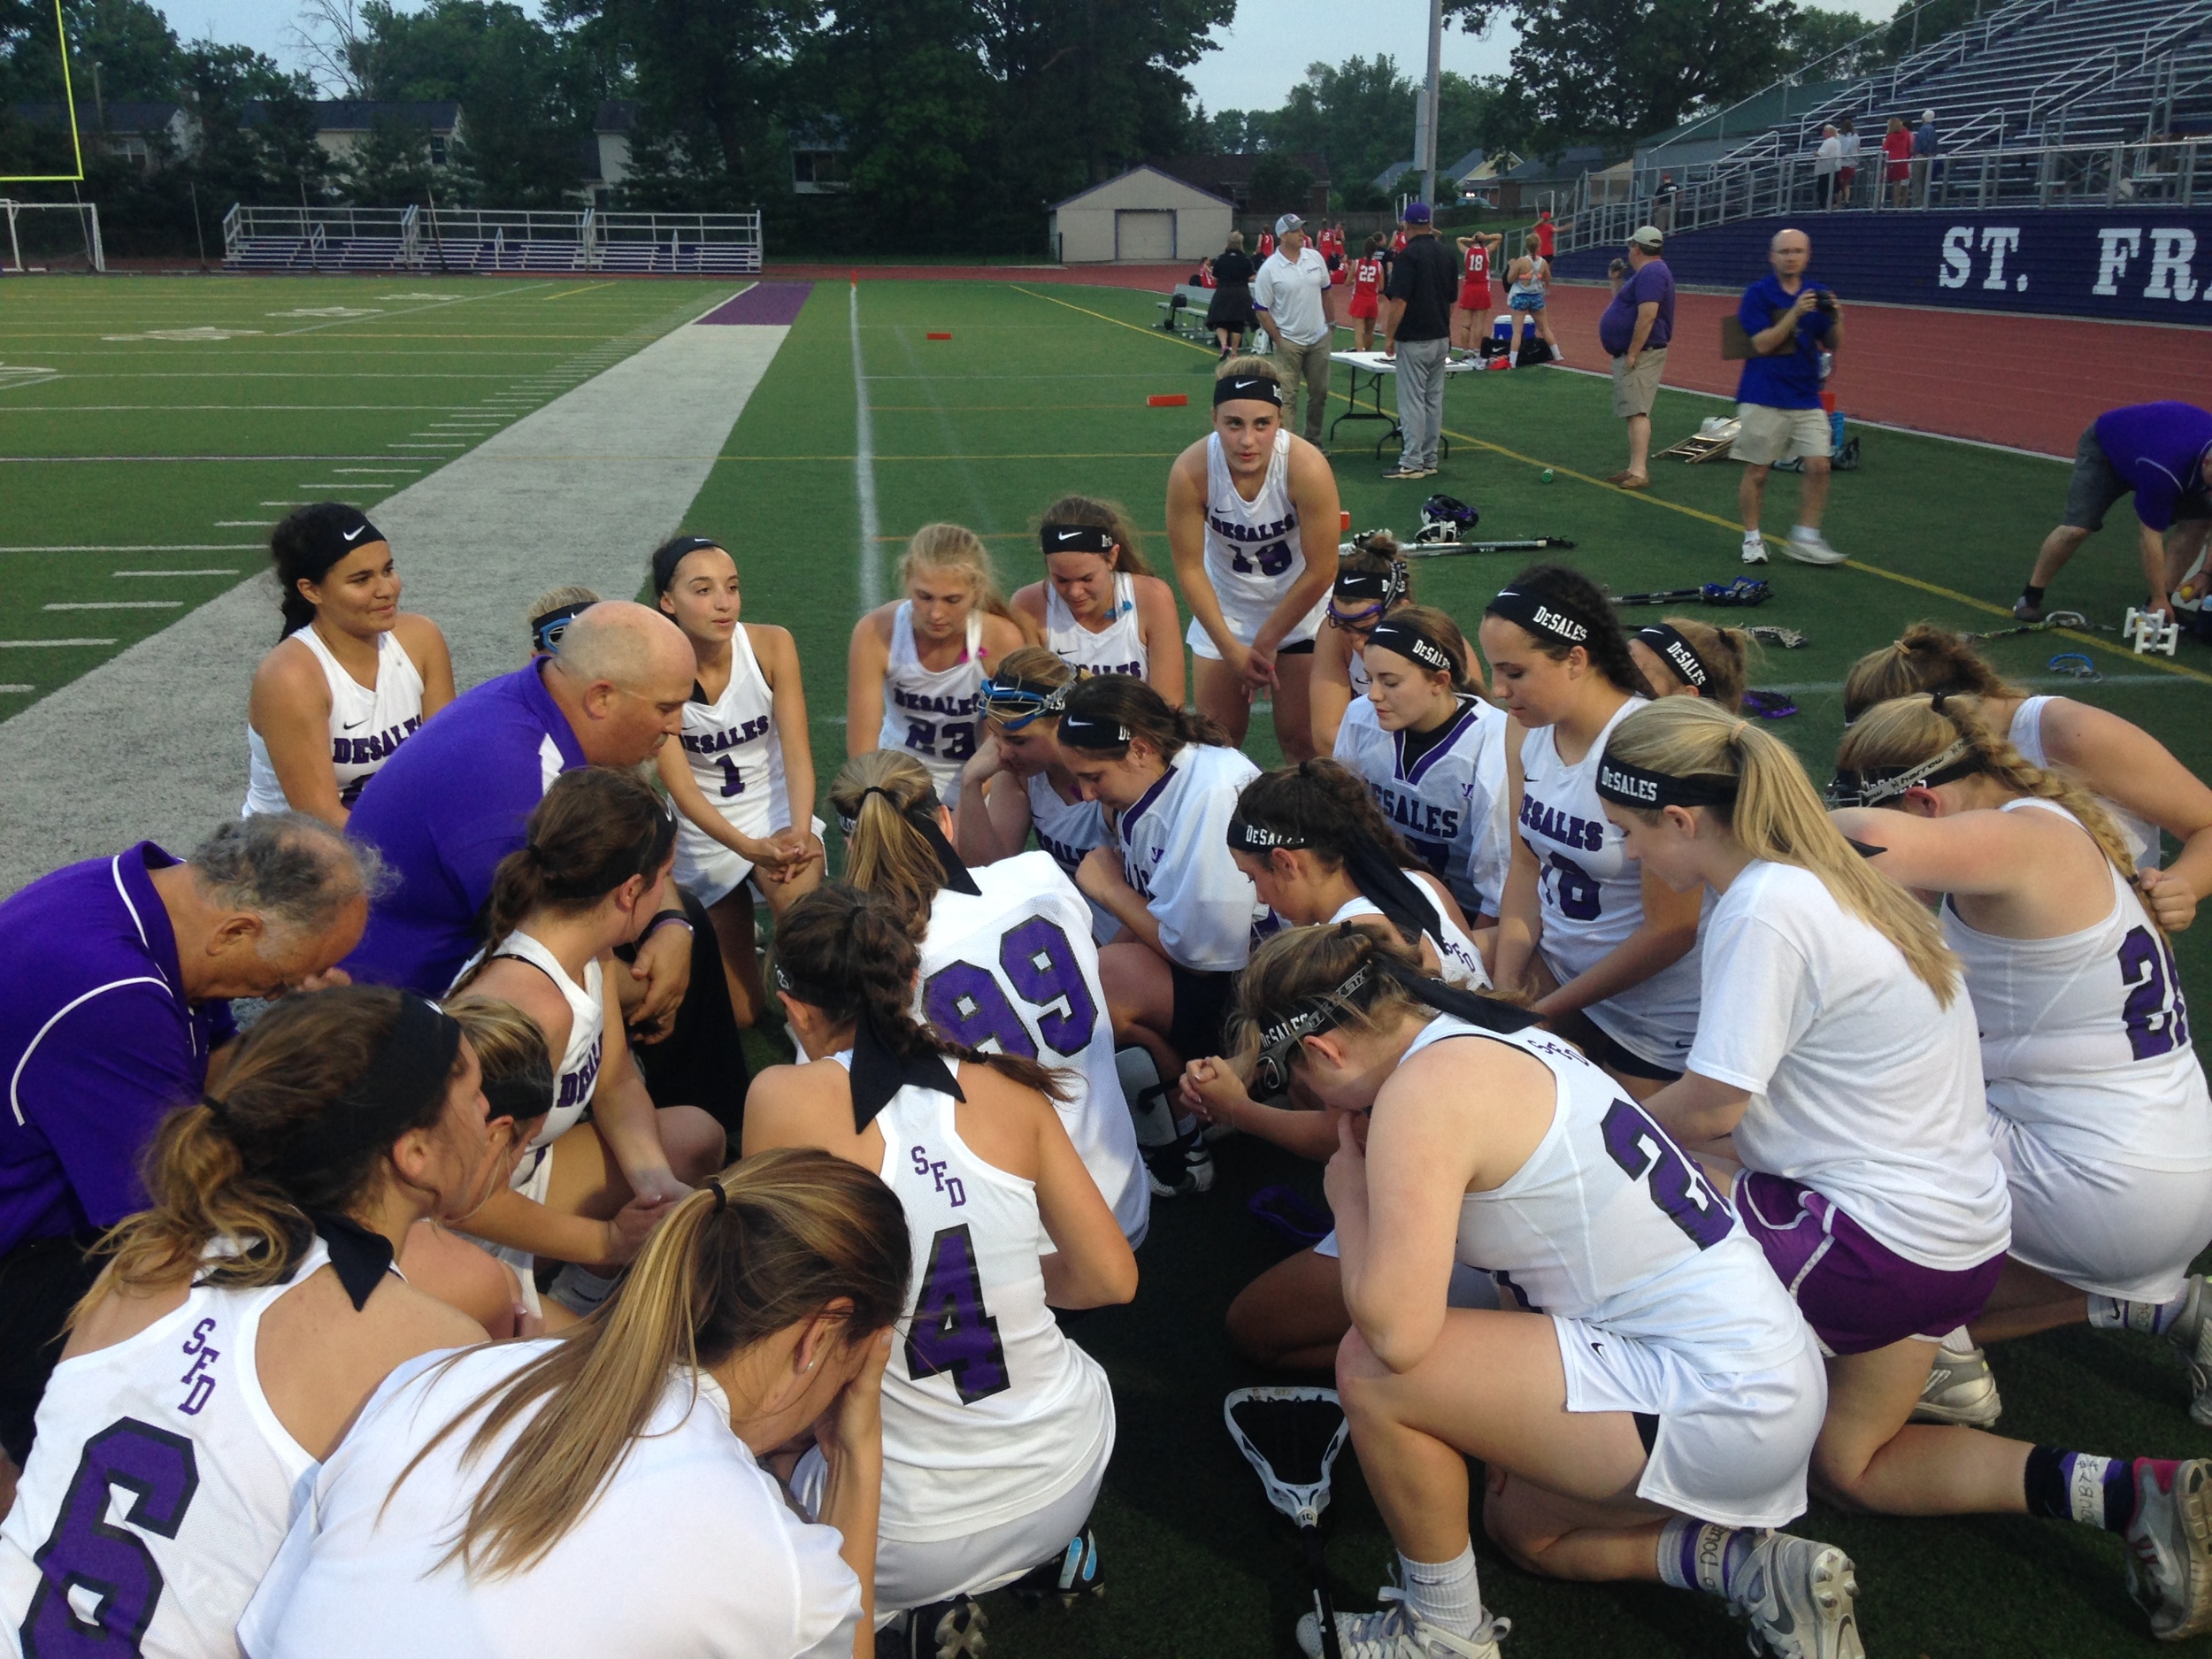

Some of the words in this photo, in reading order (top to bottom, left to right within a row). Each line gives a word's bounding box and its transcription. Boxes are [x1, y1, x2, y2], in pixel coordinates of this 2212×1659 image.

[1358, 265, 1377, 283] 22
[1469, 254, 1484, 272] 18
[1939, 227, 2028, 292] ST.
[2092, 227, 2212, 302] FR
[1210, 513, 1295, 542] DESALES
[679, 715, 769, 754] ESALES
[904, 715, 977, 761] 23
[714, 753, 745, 798] 1
[1520, 793, 1604, 852] ESALES
[921, 914, 1098, 1060] 99
[1527, 1040, 1589, 1067] SFD
[910, 1145, 967, 1207] SFD
[1600, 1097, 1733, 1250] 2
[904, 1223, 1011, 1406] 4
[178, 1317, 219, 1416] SFD
[19, 1416, 199, 1659] 6
